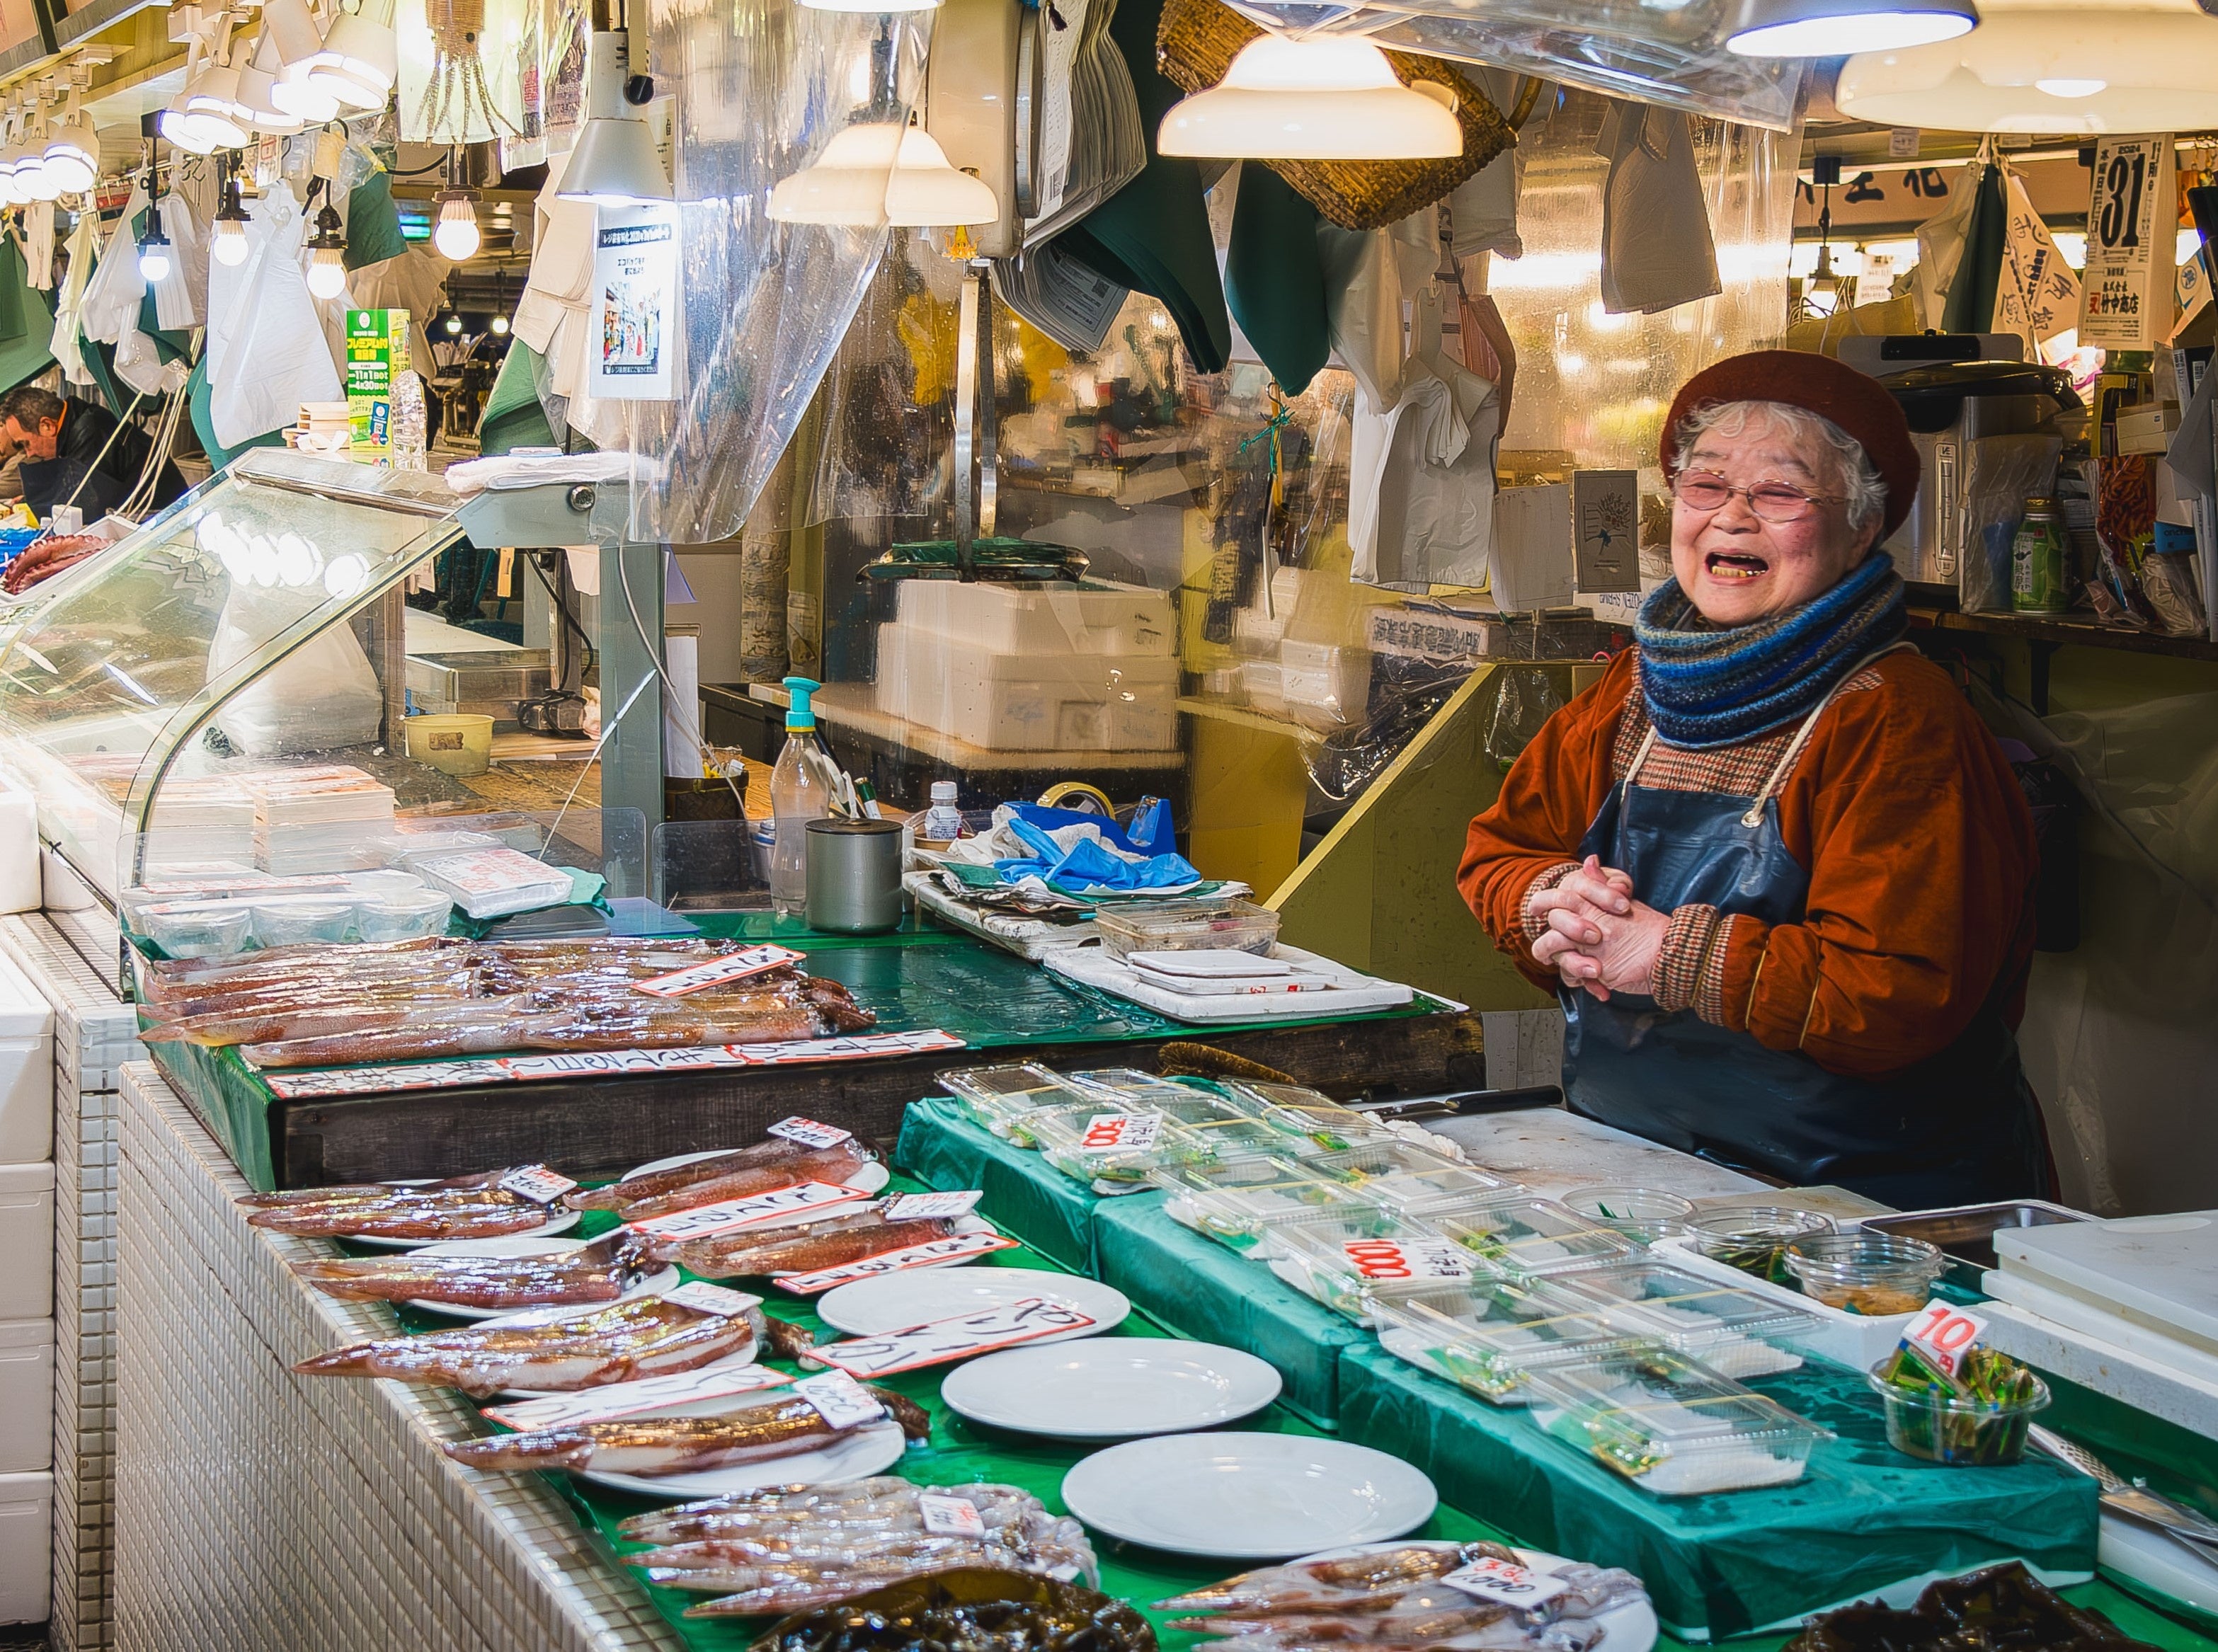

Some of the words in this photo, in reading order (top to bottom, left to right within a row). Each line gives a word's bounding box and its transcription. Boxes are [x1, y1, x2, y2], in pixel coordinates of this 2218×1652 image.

[2099, 153, 2146, 248] 31
[1344, 1239, 1412, 1278] 1000
[1913, 1307, 1977, 1353] 10
